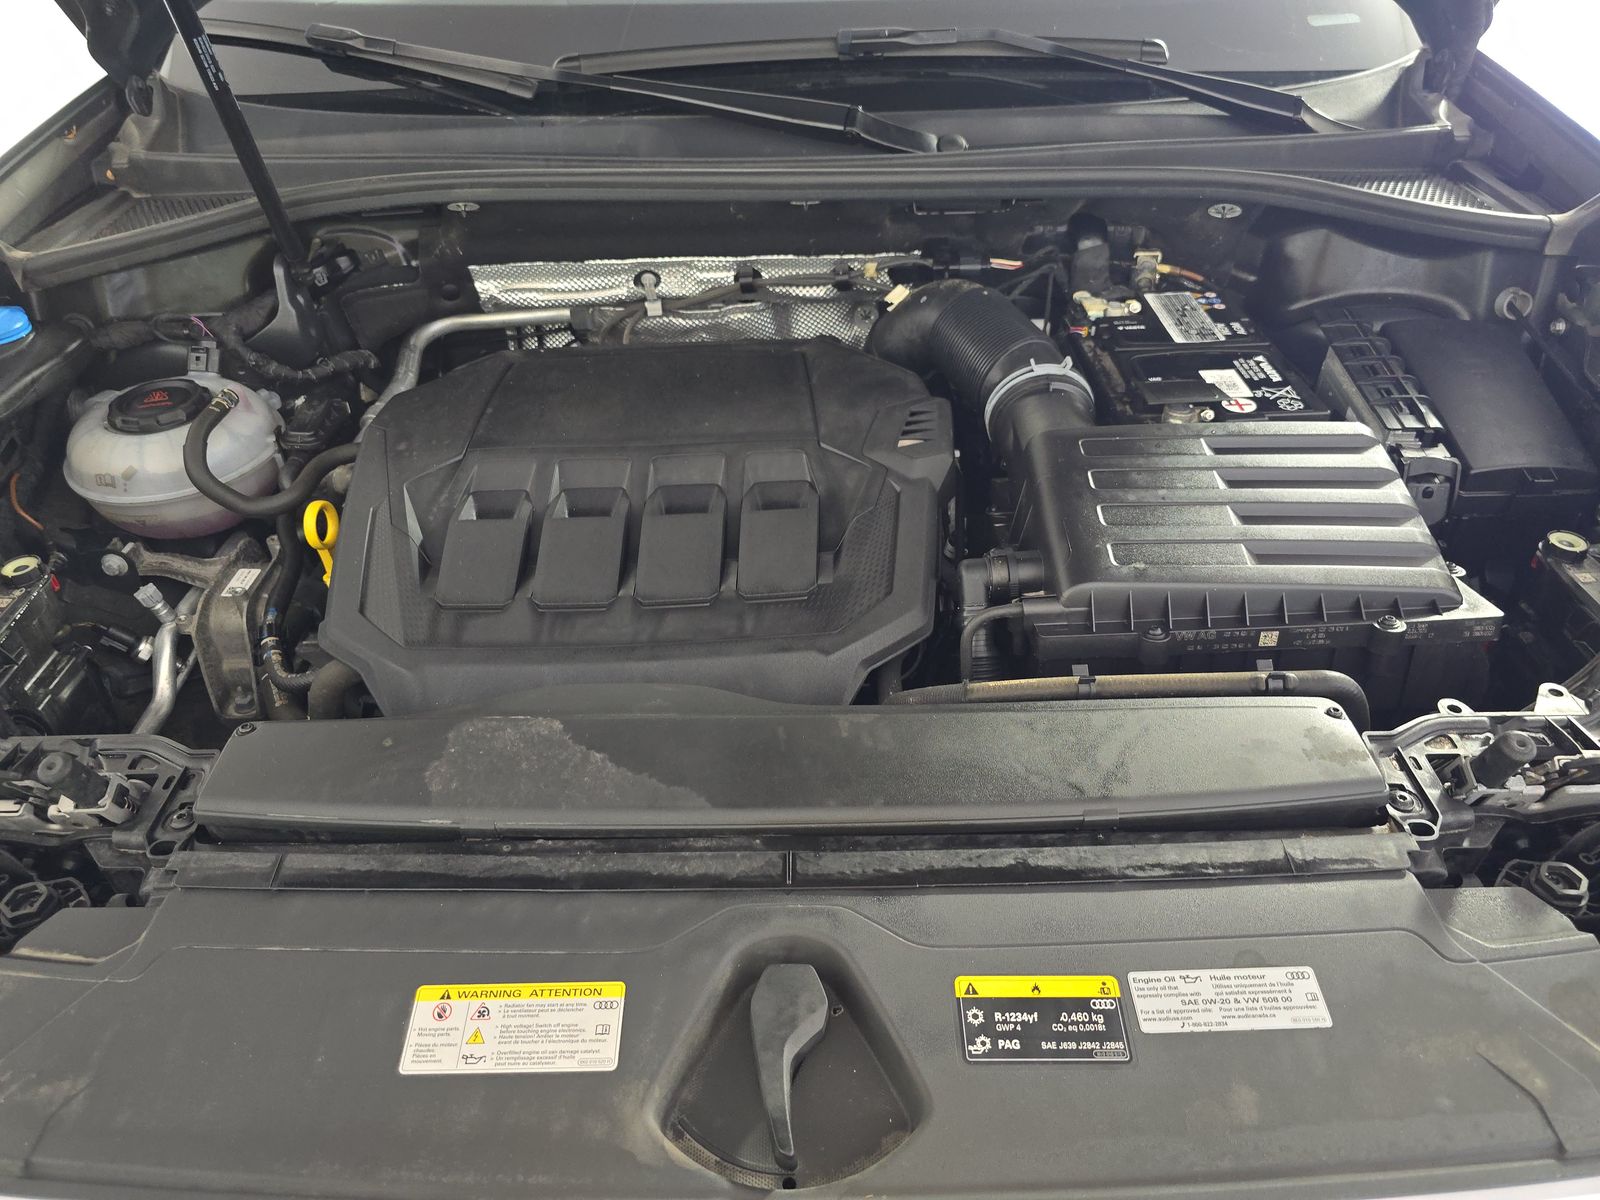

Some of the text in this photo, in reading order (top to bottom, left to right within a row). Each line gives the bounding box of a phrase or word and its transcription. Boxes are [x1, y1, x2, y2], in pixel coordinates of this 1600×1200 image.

[1132, 977, 1162, 985] Engine
[457, 987, 603, 999] WARNING ATTENTION
[994, 1011, 1038, 1024] R-1234yf
[1091, 1011, 1104, 1024] kg
[996, 1023, 1022, 1032] GWP 4
[1068, 1024, 1078, 1033] eq
[998, 1039, 1021, 1050] PAG
[1041, 1041, 1058, 1050] SAE
[1059, 1041, 1077, 1050] J639
[1078, 1041, 1101, 1050] J2842
